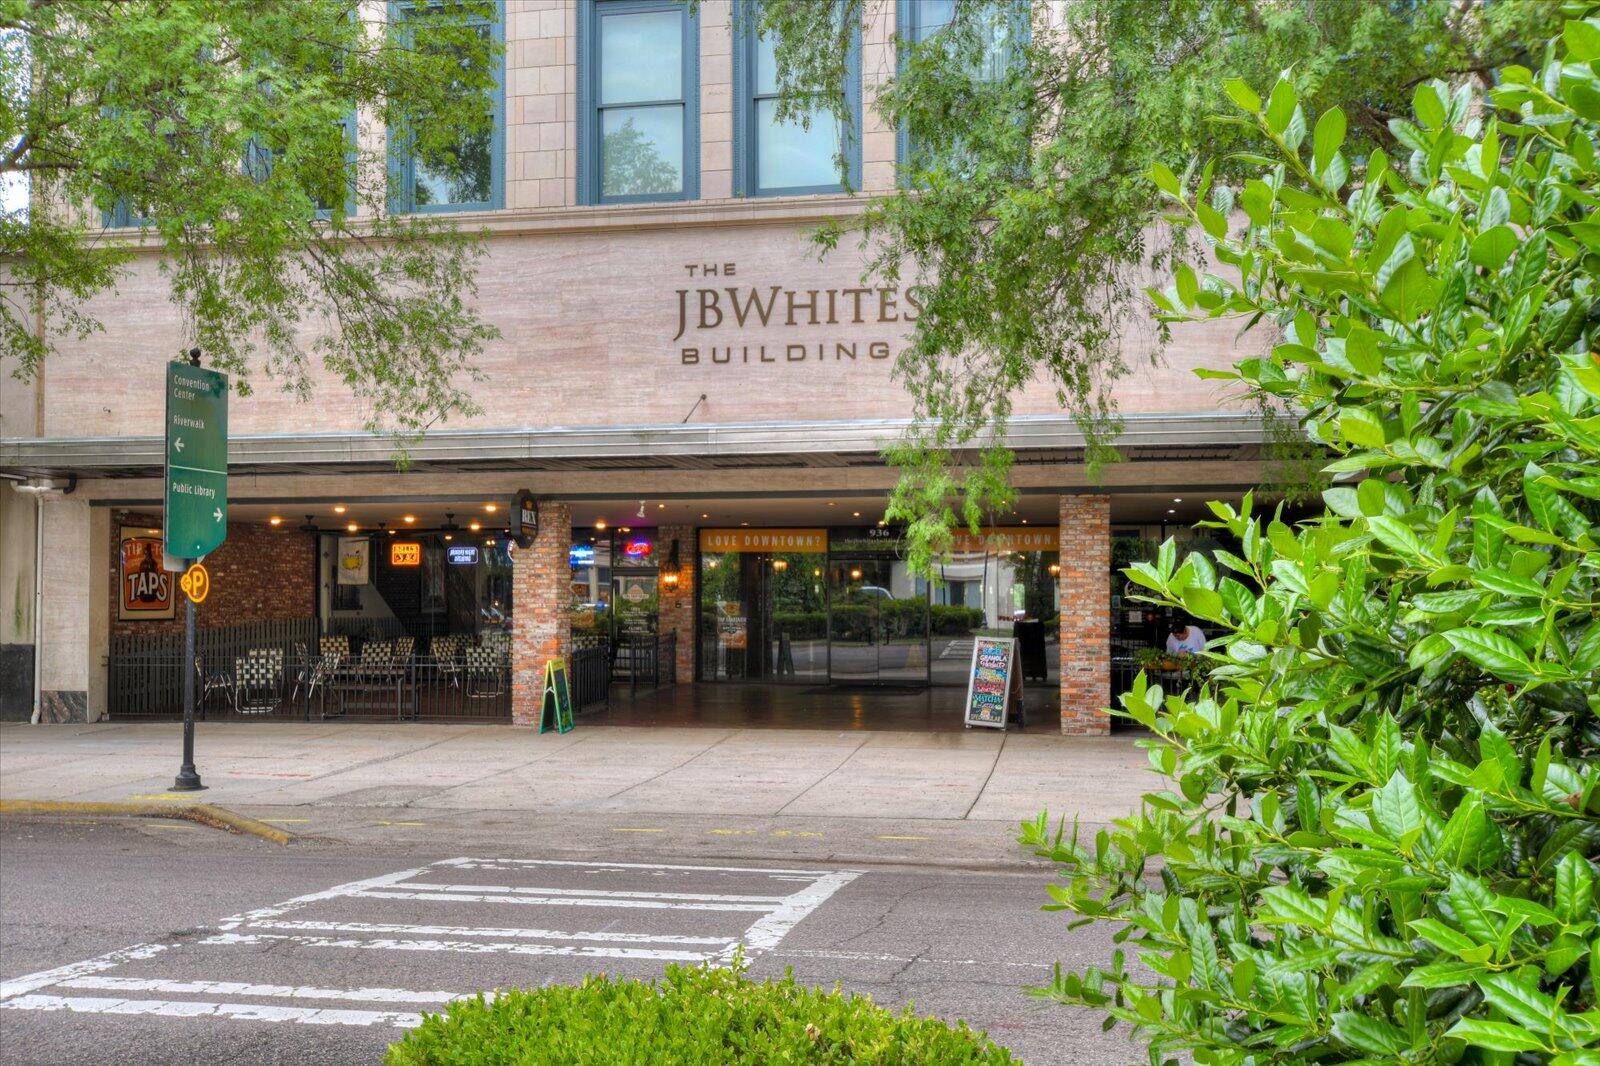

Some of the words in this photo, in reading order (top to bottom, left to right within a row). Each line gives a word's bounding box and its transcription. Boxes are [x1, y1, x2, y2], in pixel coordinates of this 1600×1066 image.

[685, 263, 736, 277] THE
[682, 341, 890, 365] BUILDING
[173, 375, 210, 391] Convention
[173, 388, 196, 400] Center
[173, 415, 205, 429] Riverwalk
[172, 482, 192, 495] Public
[194, 485, 216, 500] Library
[869, 529, 890, 537] 936
[707, 535, 738, 547] LOVE
[744, 535, 821, 547] DOWNTOWN?
[124, 543, 142, 556] TIP
[128, 571, 168, 602] TAPS
[192, 571, 204, 596] P
